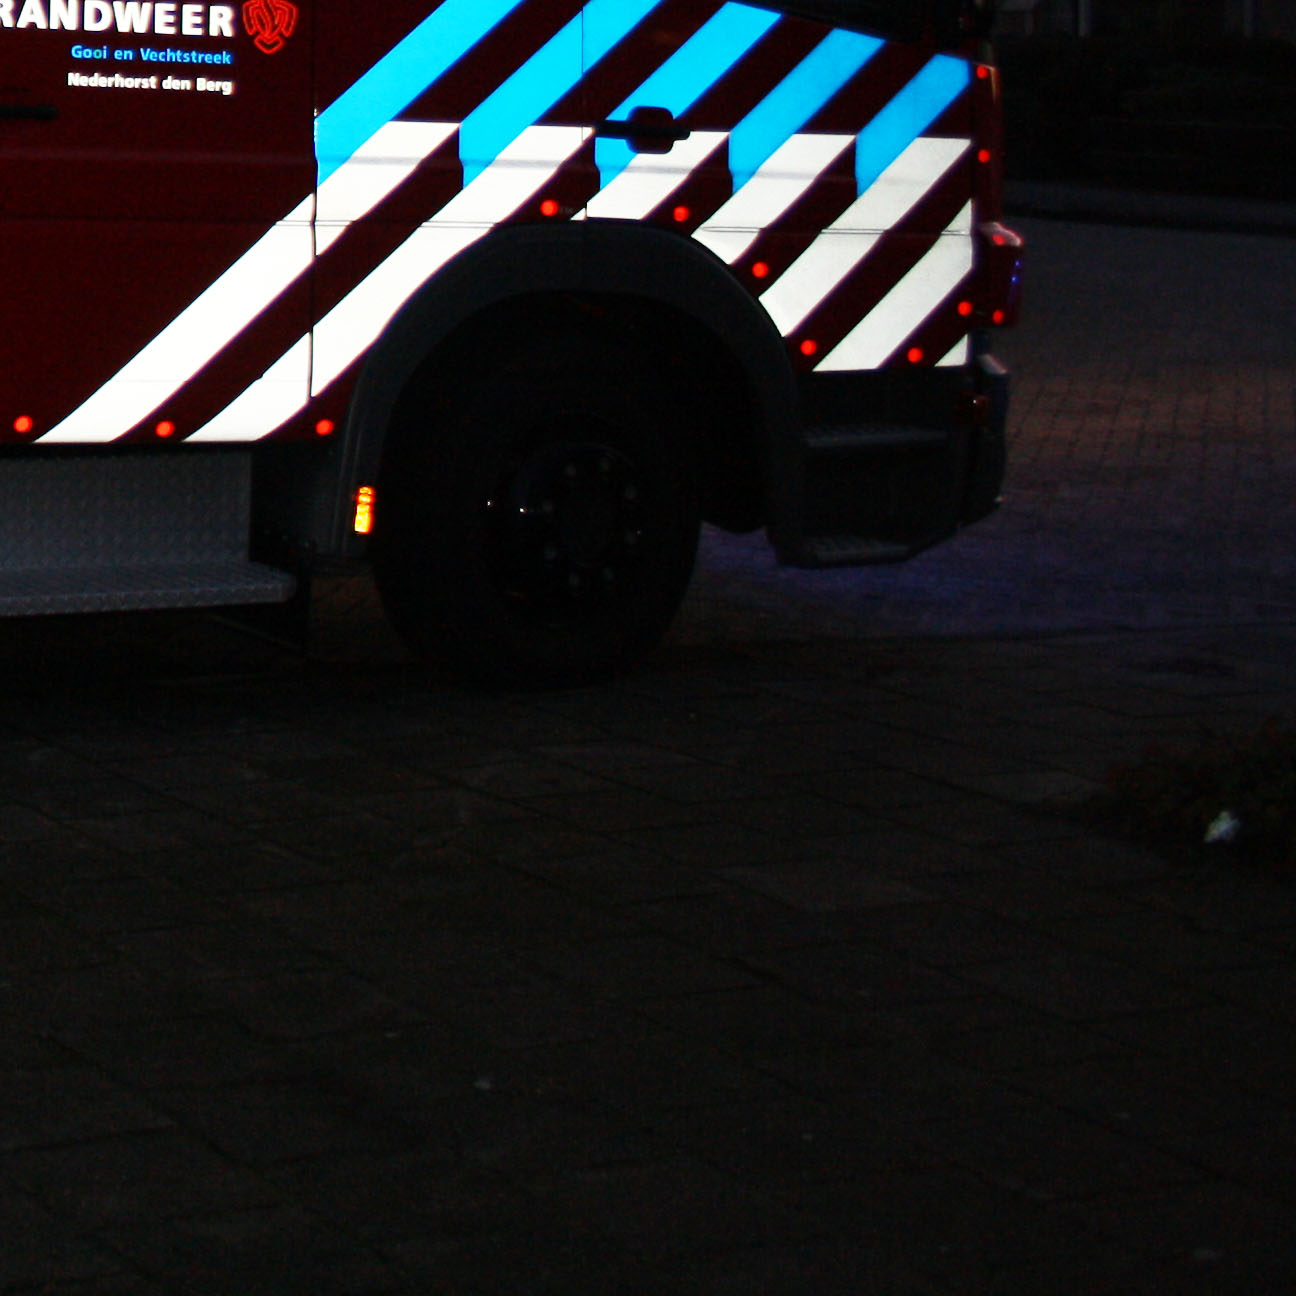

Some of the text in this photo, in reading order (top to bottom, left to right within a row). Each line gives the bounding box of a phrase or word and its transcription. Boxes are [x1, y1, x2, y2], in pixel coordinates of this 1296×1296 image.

[71, 44, 231, 65] Gooi en Vechtstreek
[67, 71, 233, 96] Nederhorst den Berg
